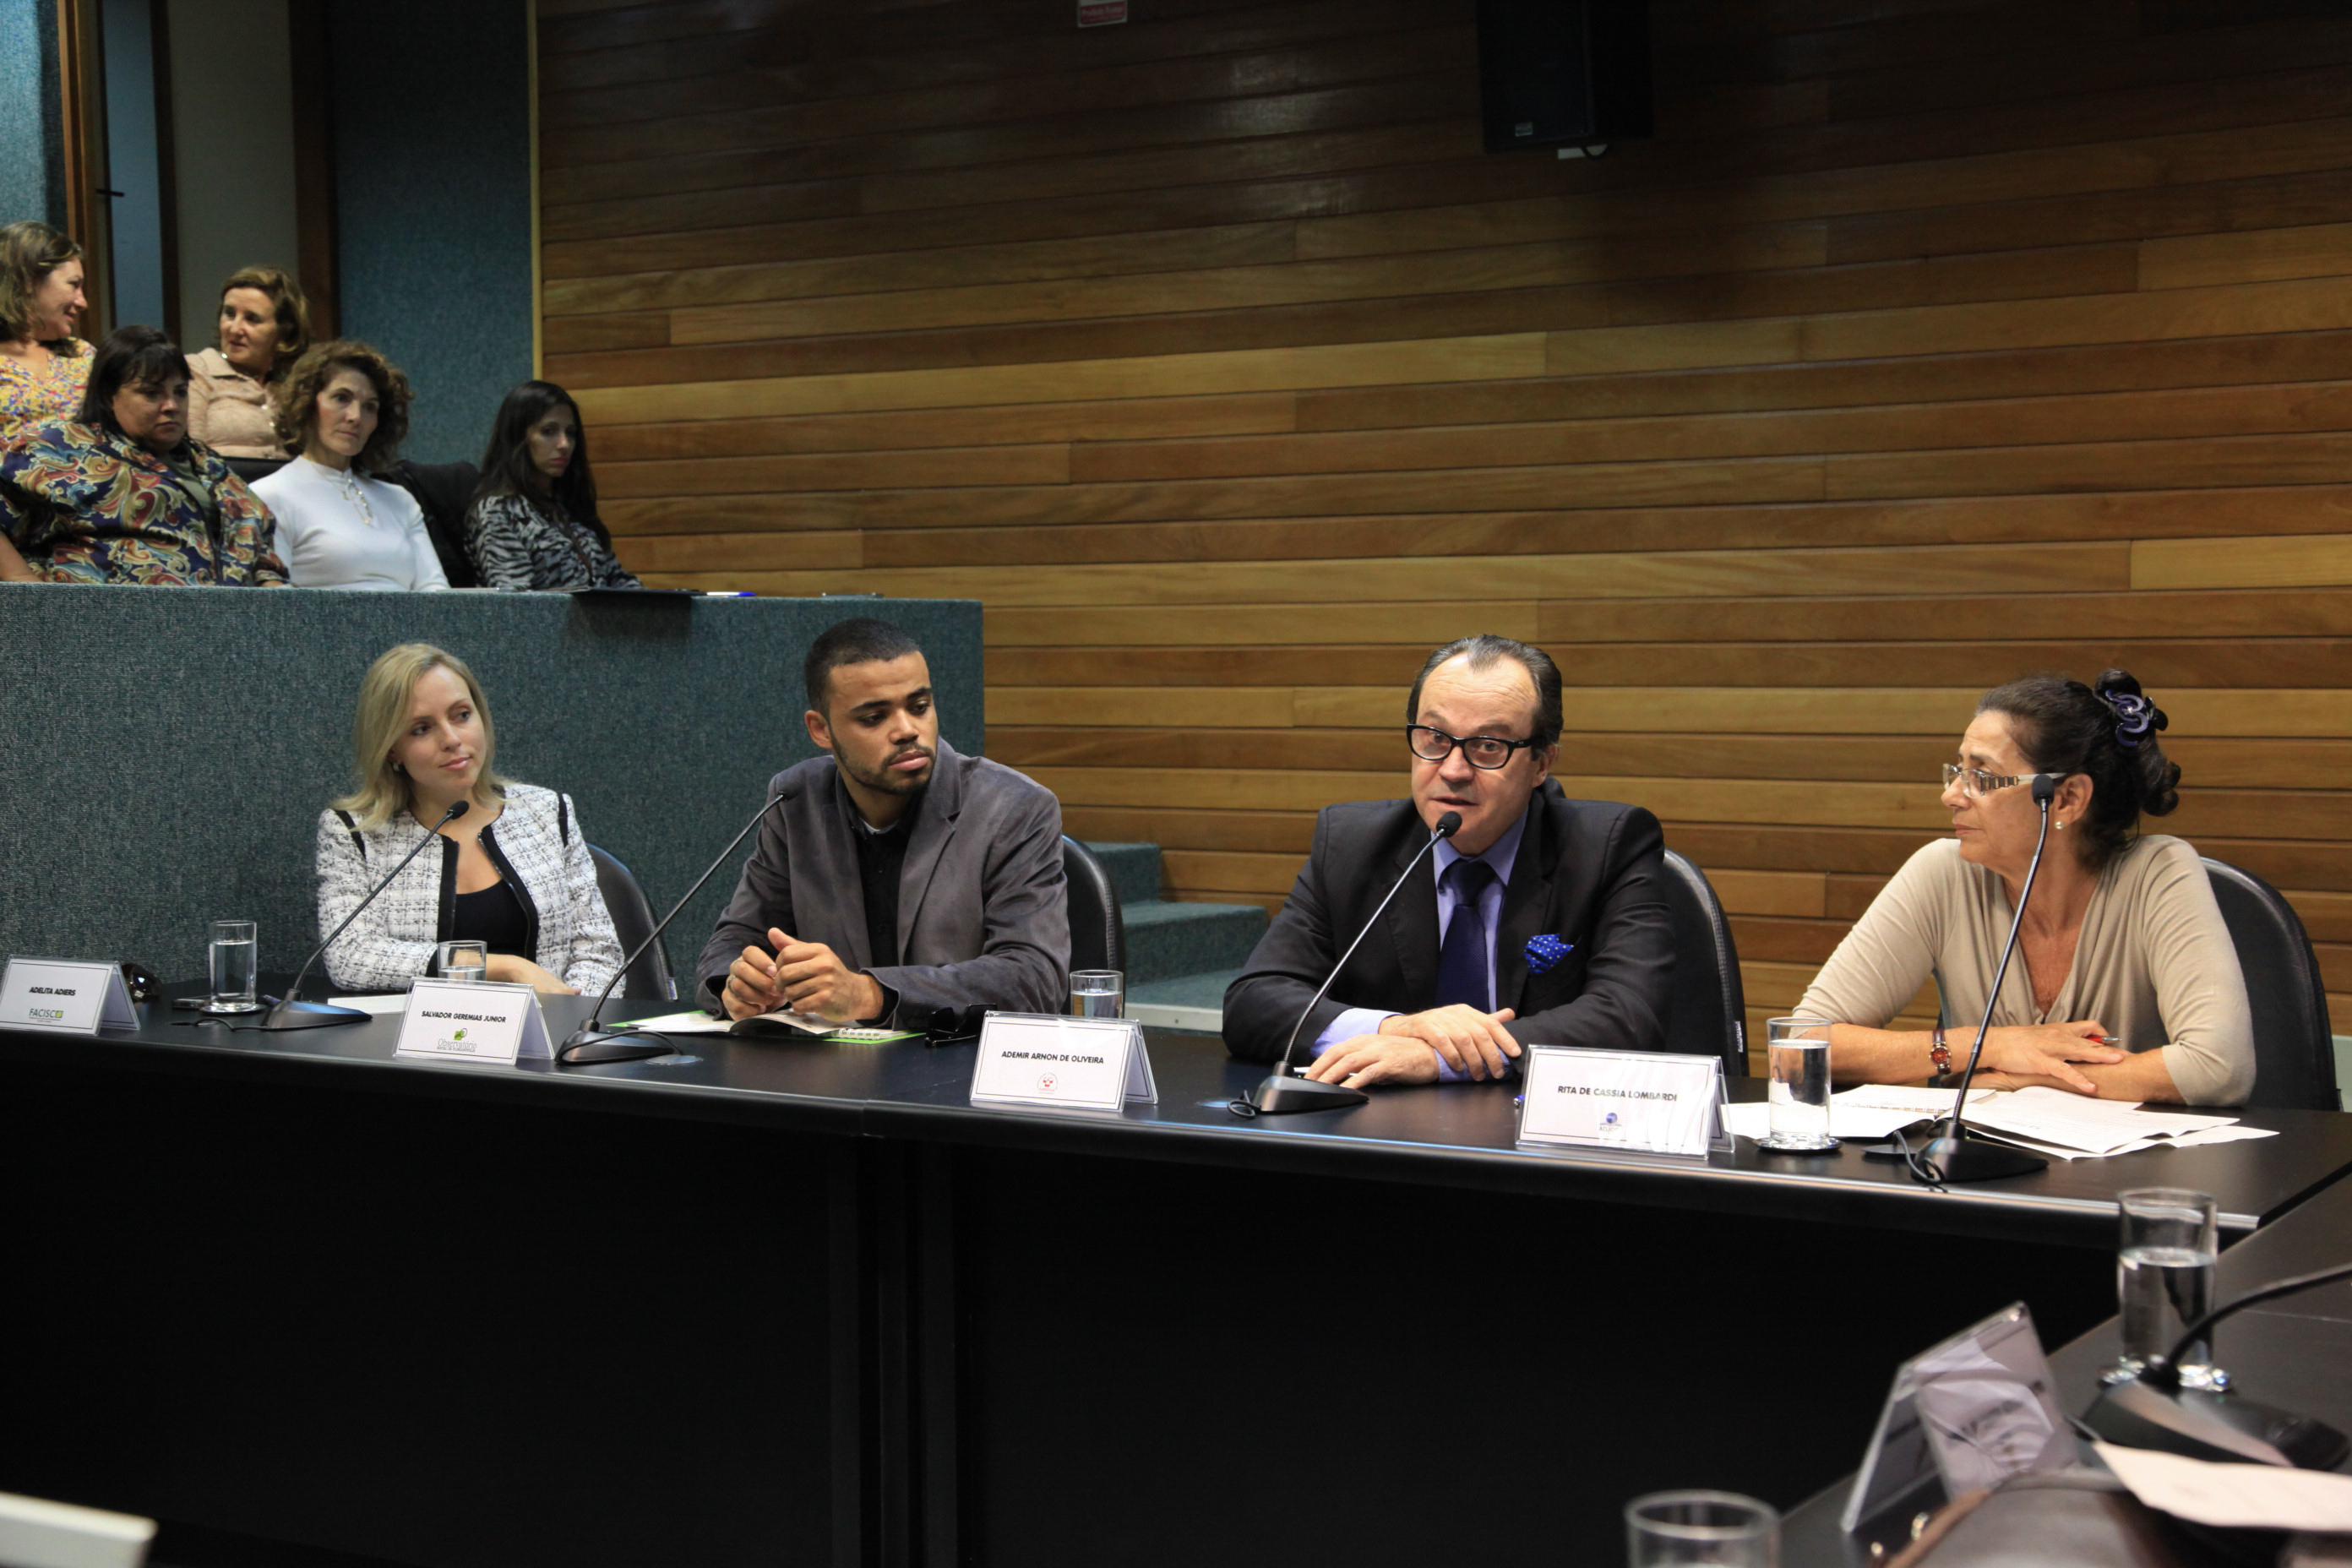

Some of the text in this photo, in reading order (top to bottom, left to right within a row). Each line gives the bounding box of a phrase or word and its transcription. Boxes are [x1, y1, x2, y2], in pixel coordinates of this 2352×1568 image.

[454, 1013, 482, 1021] GEREMIAS
[1001, 1051, 1029, 1059] ADEMIR
[1031, 1053, 1058, 1061] ARNON
[1071, 1055, 1104, 1064] OLIVEIRA
[1558, 1086, 1678, 1102] RITA DE CASSIA LOMBARDI
